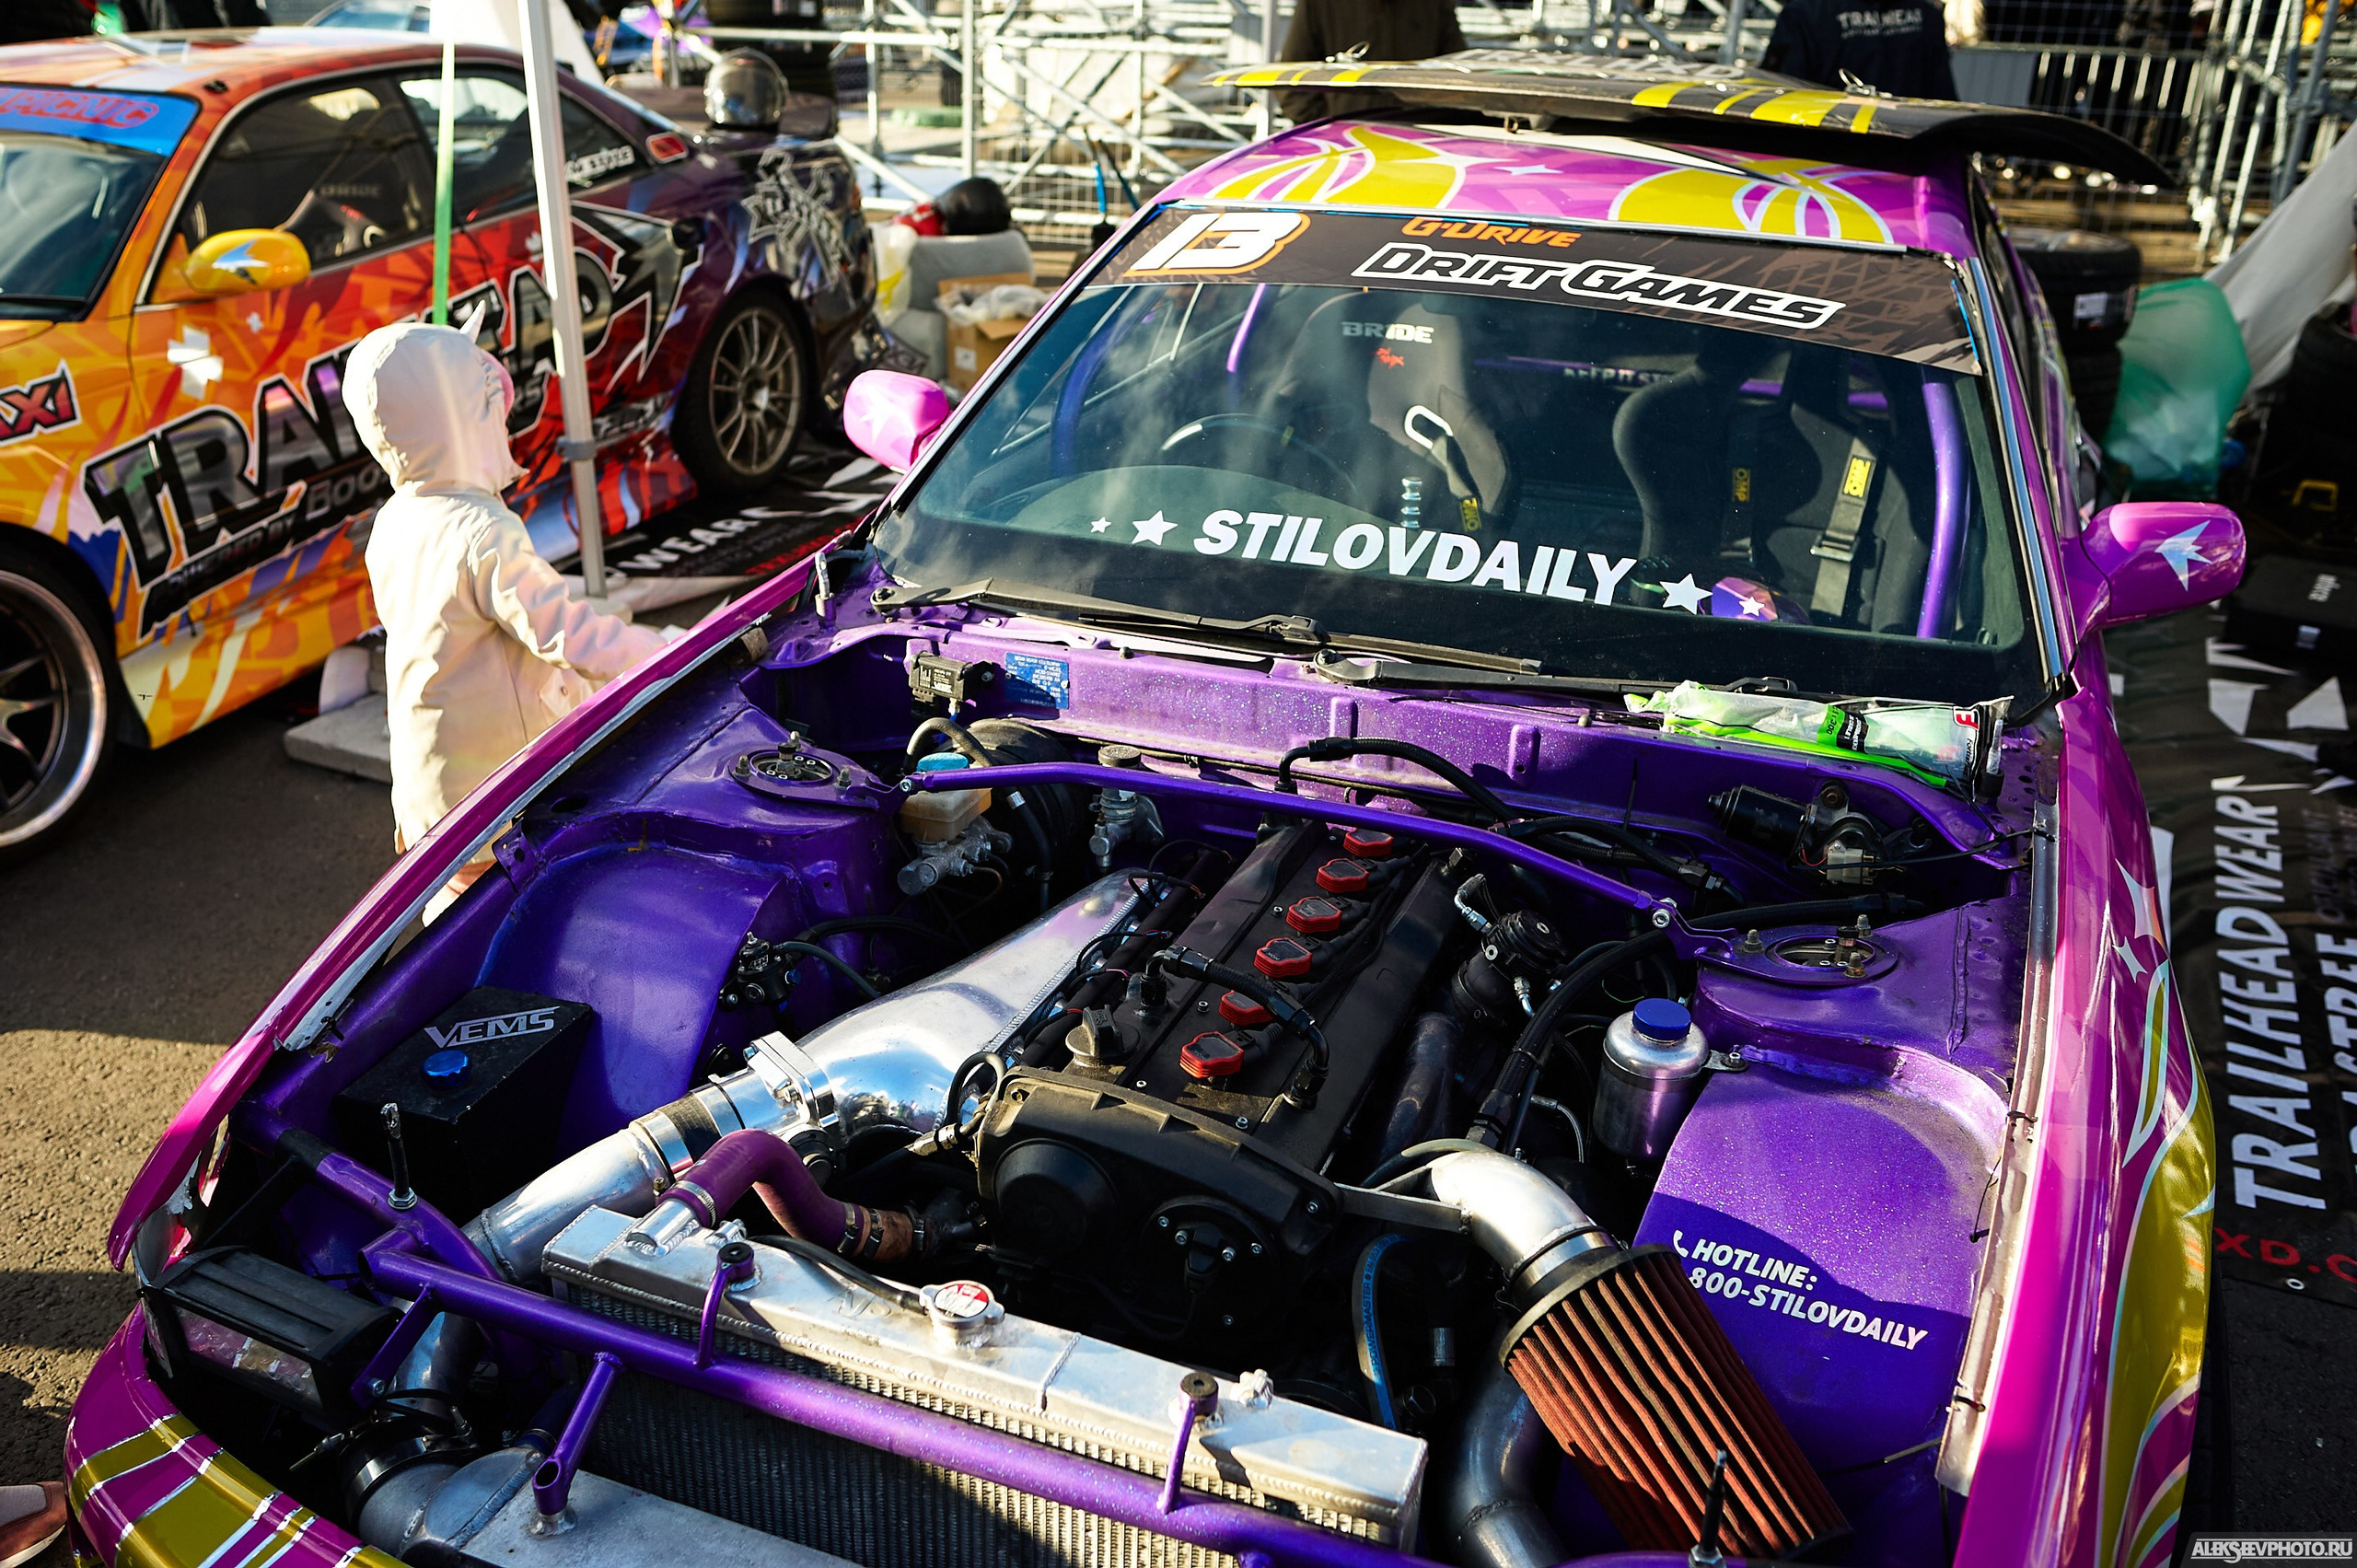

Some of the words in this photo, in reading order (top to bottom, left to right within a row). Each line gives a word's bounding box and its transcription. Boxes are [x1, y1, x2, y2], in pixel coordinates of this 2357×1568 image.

[1341, 321, 1434, 344] BRIDE
[1193, 509, 1637, 606] STILOVDAILY
[424, 1005, 560, 1049] VEMS
[1690, 1238, 1818, 1291] HOTLINE:
